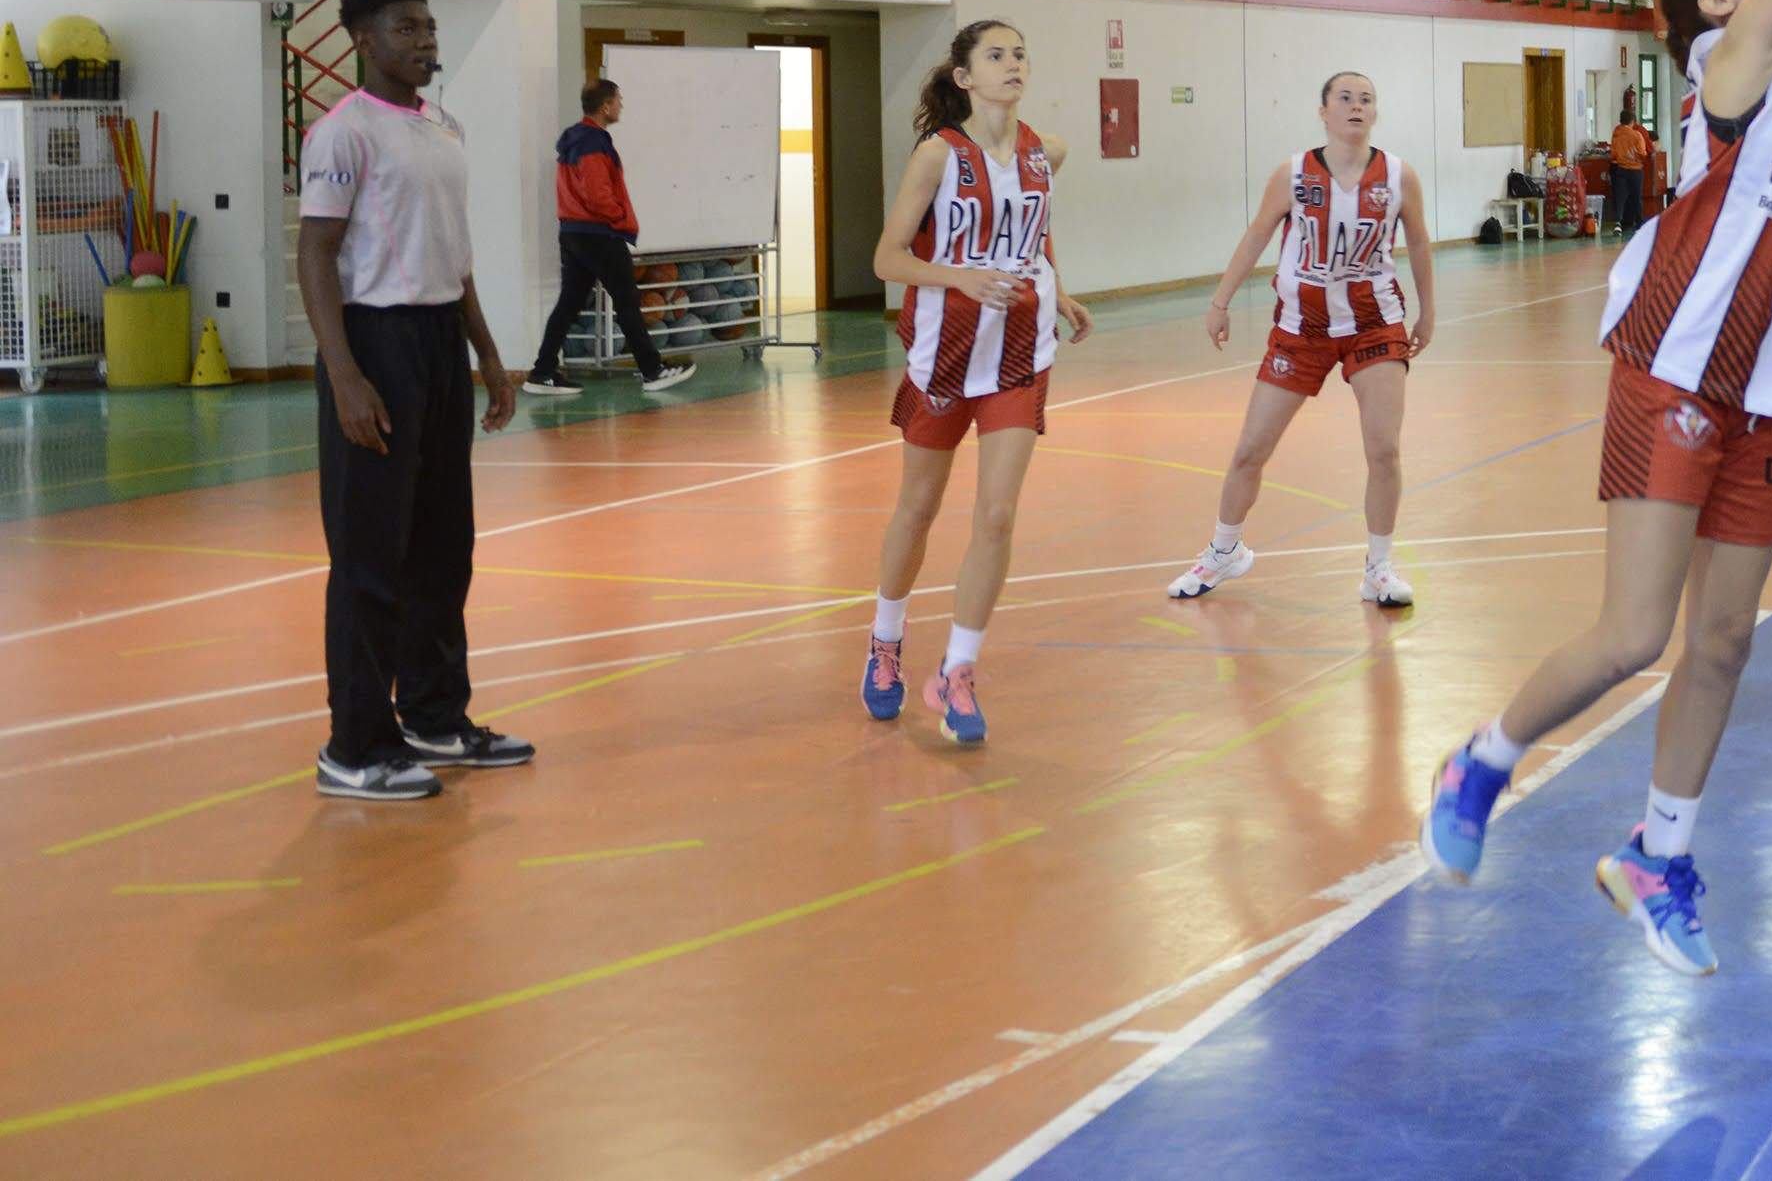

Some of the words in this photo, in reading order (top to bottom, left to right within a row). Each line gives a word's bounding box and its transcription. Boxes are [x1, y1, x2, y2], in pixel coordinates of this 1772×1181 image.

[959, 158, 977, 186] 3
[1294, 185, 1323, 207] 20
[1296, 215, 1384, 272] PLAZA
